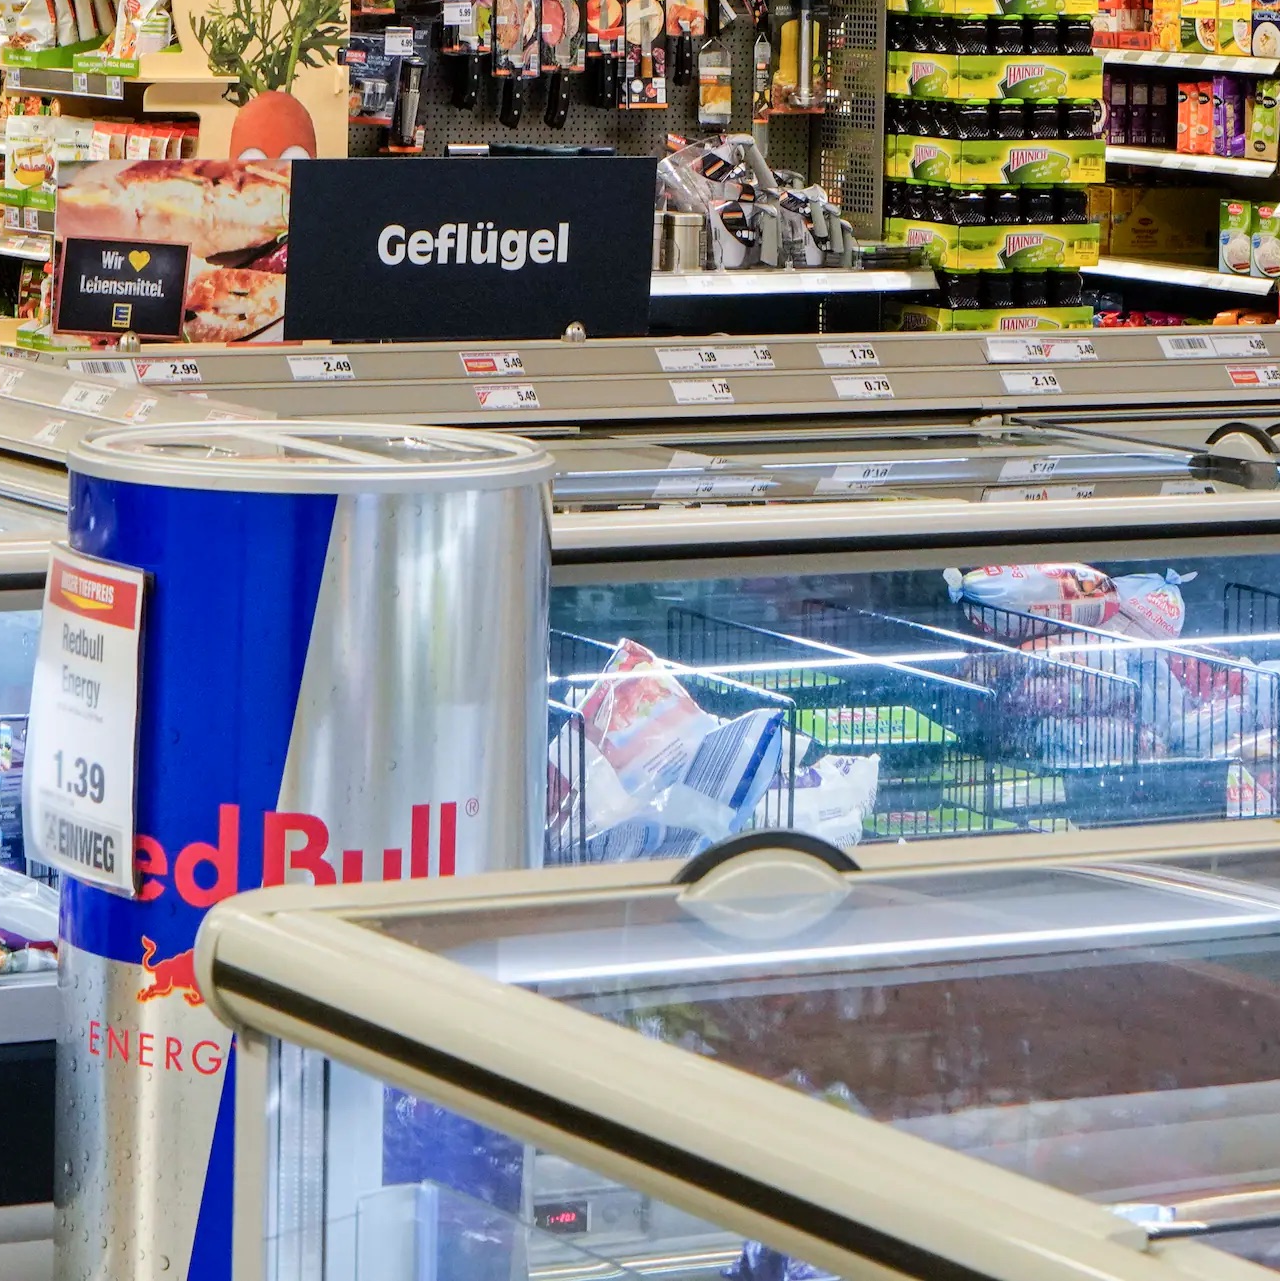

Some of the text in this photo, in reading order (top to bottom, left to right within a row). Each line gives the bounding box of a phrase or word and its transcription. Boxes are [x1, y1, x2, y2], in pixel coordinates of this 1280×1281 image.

[1008, 66, 1044, 87] HAINICH
[1011, 150, 1048, 171] HAINICH
[377, 222, 570, 272] Geflügel
[1007, 235, 1044, 256] HAINICH
[101, 250, 124, 270] Wir
[79, 274, 165, 298] Lebensmittel.
[1026, 344, 1042, 356] 3.79
[1078, 344, 1095, 355] 3.49
[1249, 339, 1265, 350] 4.89
[698, 351, 717, 363] 1.39
[753, 349, 772, 360] 1.39
[849, 348, 876, 360] 1.79
[170, 362, 199, 375] 2.99
[323, 360, 351, 372] 2.49
[504, 357, 522, 368] 5.49
[1032, 375, 1057, 387] 2.19
[1264, 369, 1280, 381] 3.85
[712, 382, 731, 394] 1.79
[864, 380, 890, 392] 0.79
[517, 391, 536, 402] 5.49
[78, 578, 115, 605] TIEFPREIS
[61, 622, 104, 663] Redbull
[61, 665, 101, 710] Energy
[53, 749, 106, 805] 1.39
[58, 817, 115, 874] EINWEG
[134, 801, 457, 908] ed Bull
[88, 1020, 238, 1076] ENERG
